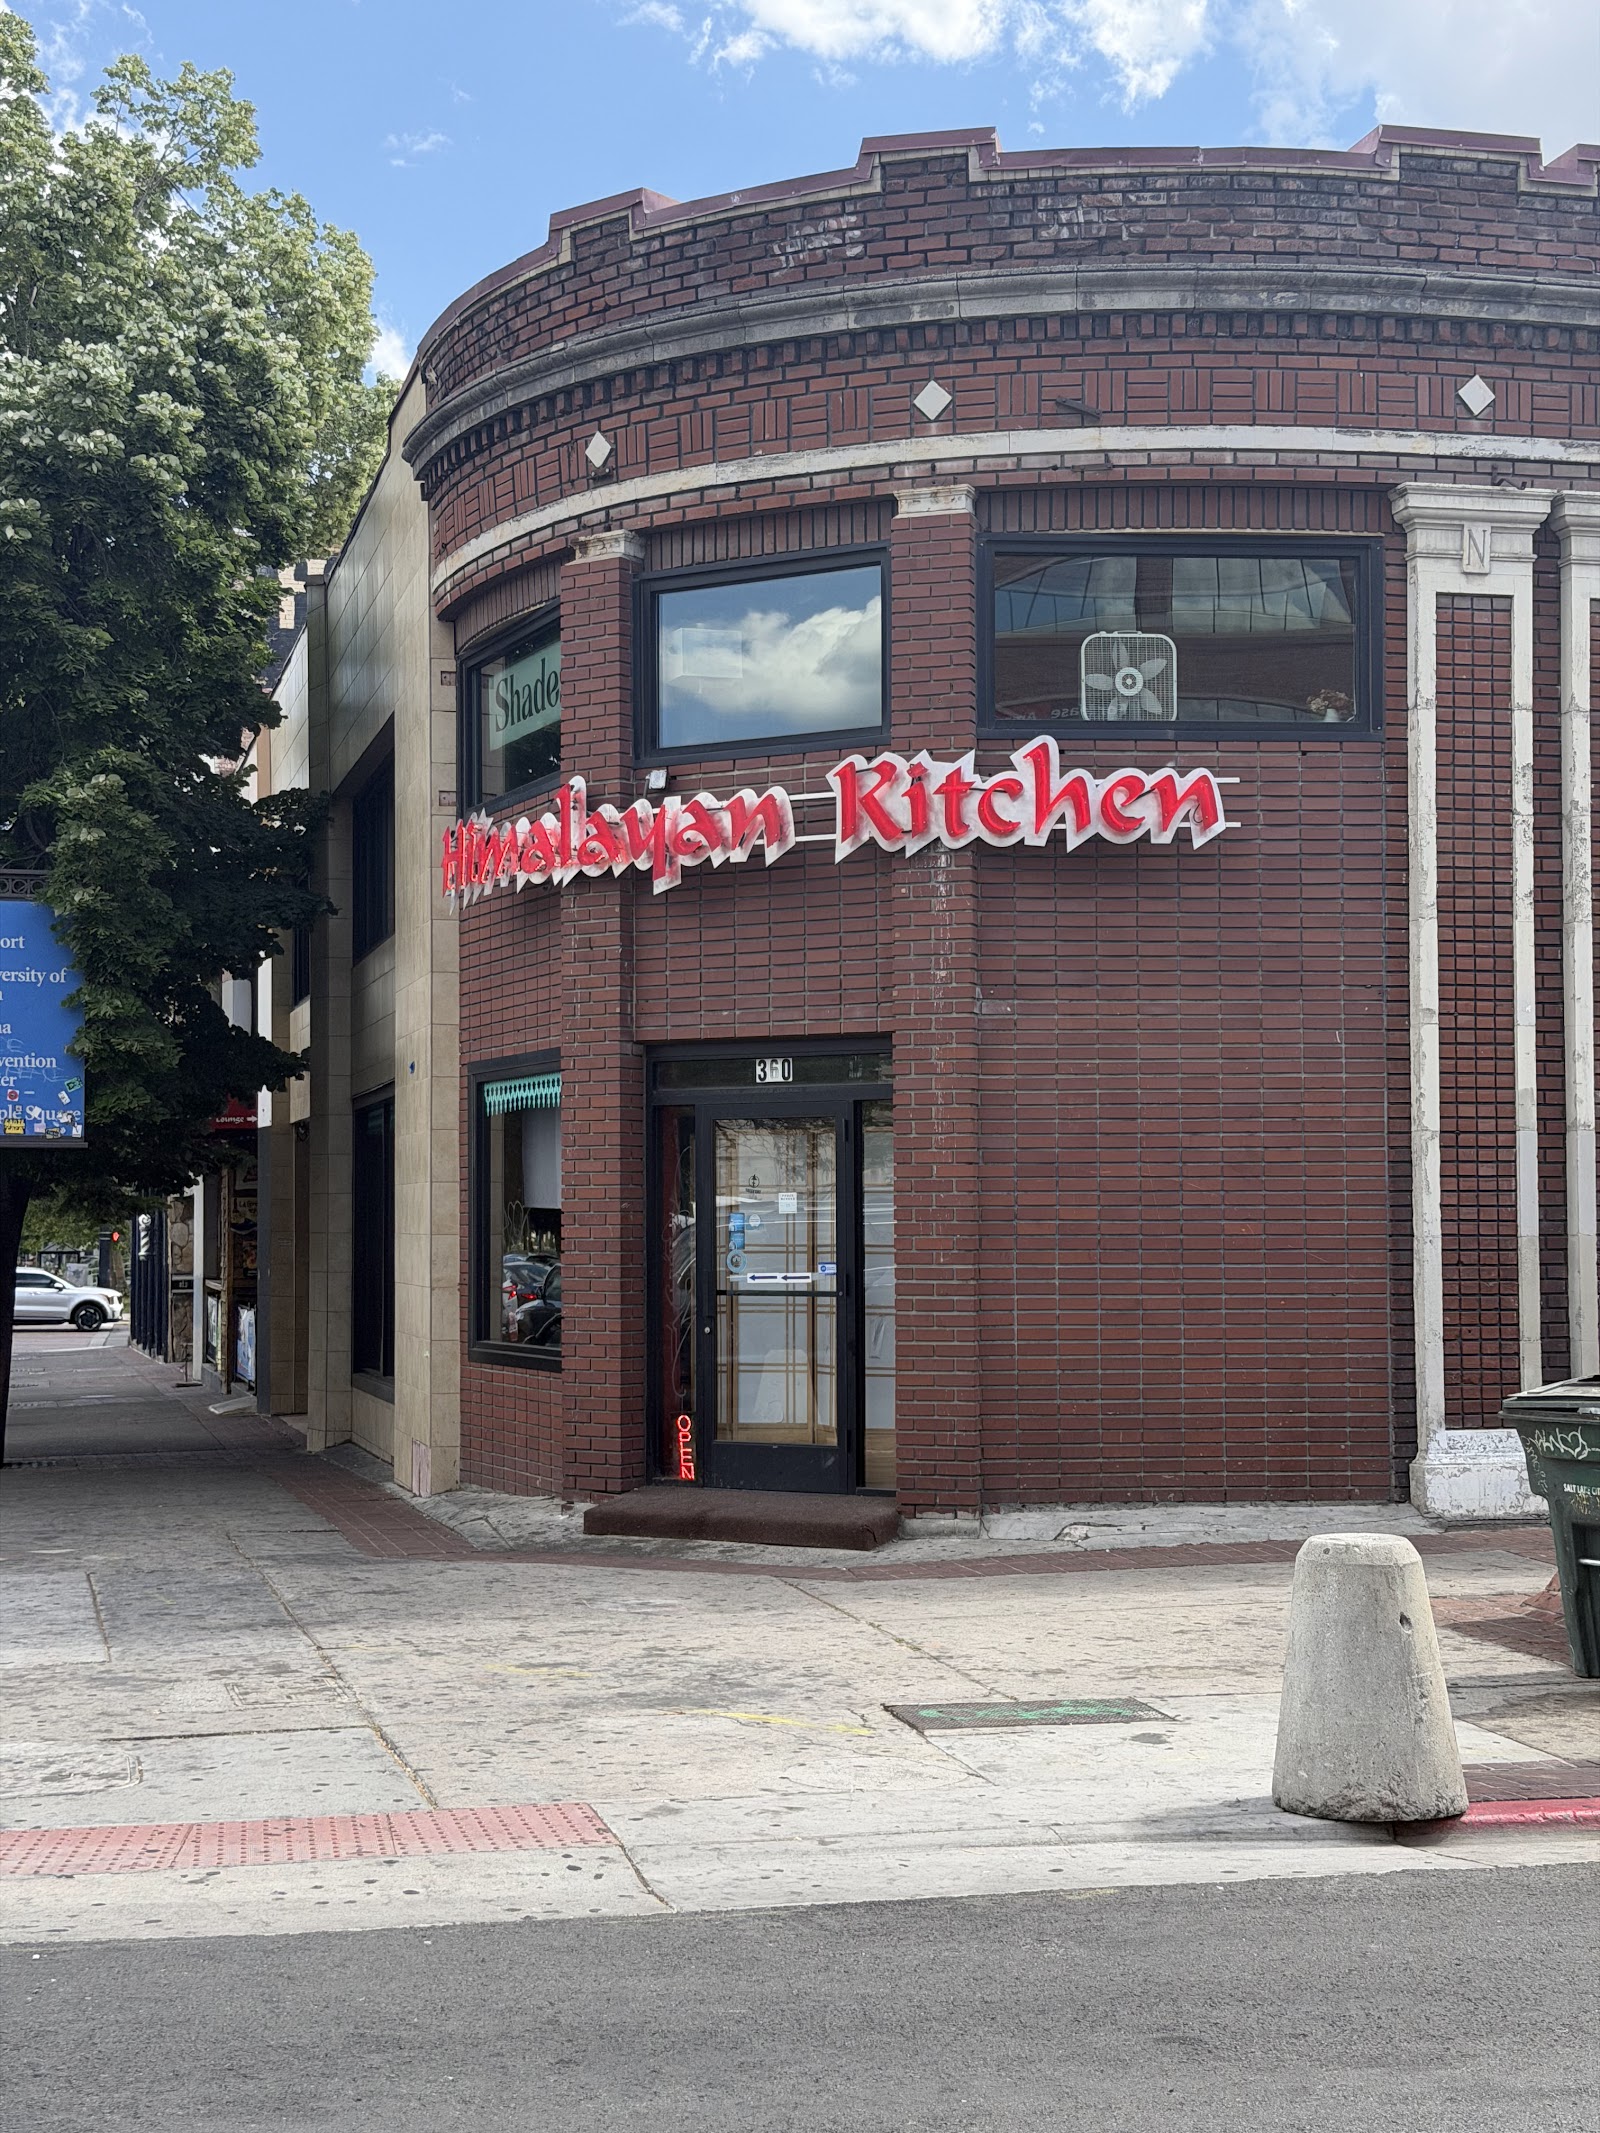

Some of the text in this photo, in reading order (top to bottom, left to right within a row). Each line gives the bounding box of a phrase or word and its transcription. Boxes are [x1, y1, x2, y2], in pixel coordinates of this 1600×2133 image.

[1466, 529, 1487, 568] N
[495, 657, 560, 732] Shade
[441, 739, 1221, 899] Himalayan Kitchen
[49, 967, 67, 983] of
[758, 1058, 791, 1081] 360
[25, 1105, 81, 1126] Sque
[676, 1414, 695, 1480] OPEN
[1563, 1483, 1576, 1493] SALT
